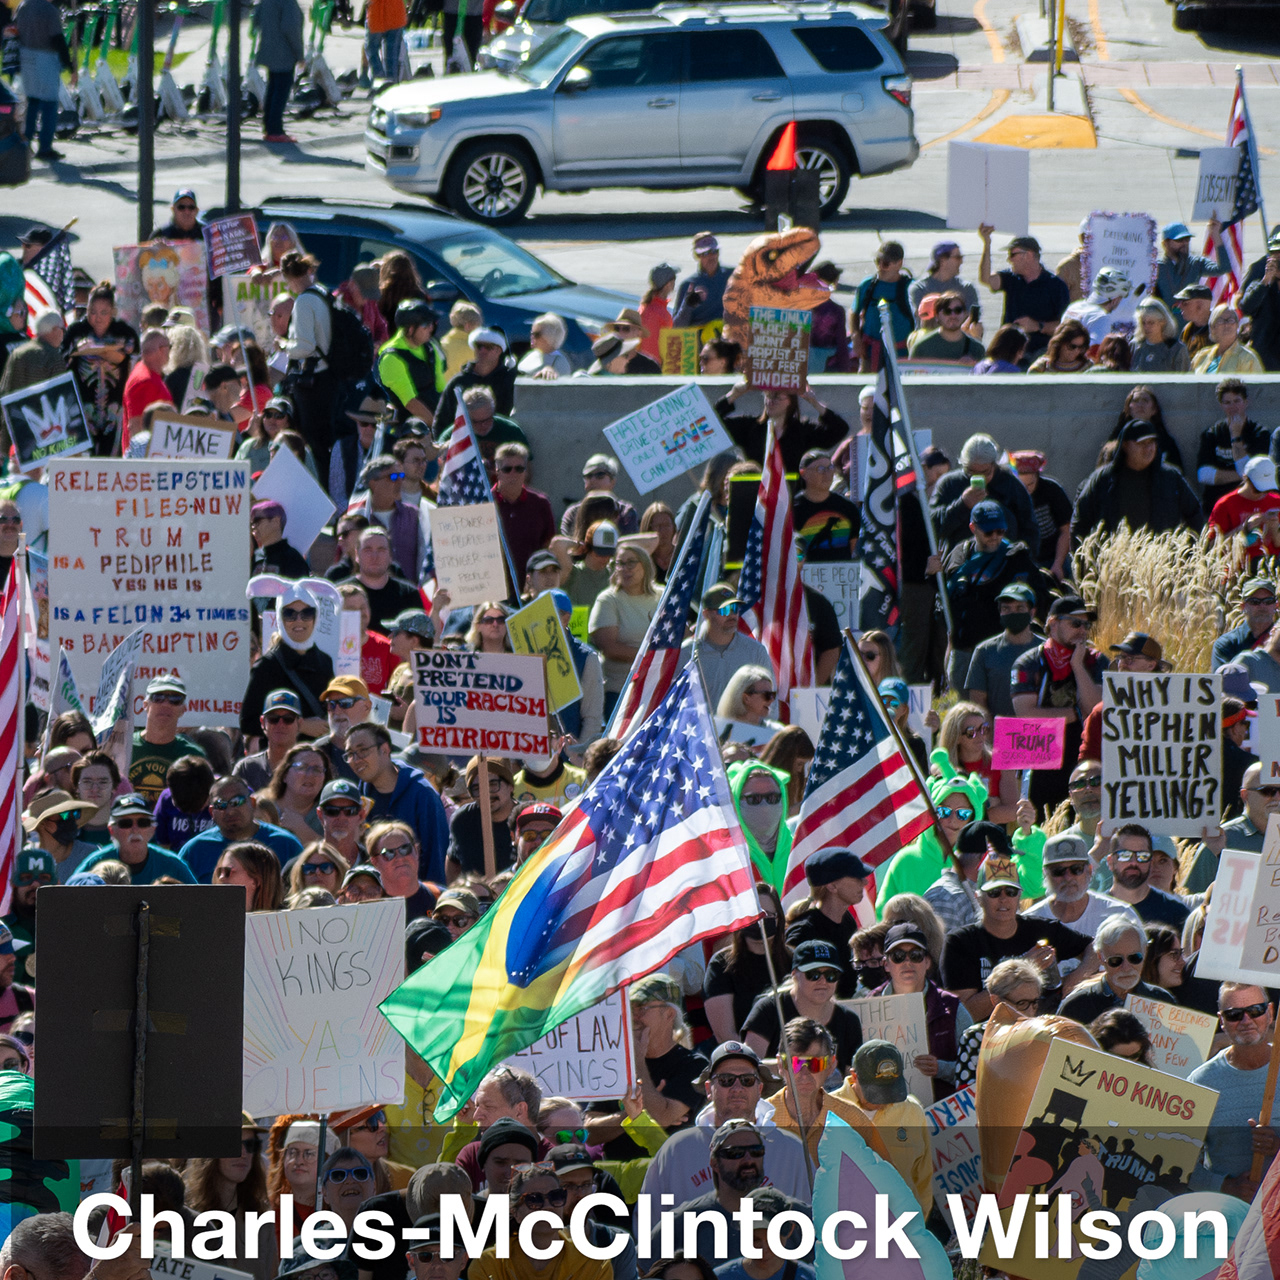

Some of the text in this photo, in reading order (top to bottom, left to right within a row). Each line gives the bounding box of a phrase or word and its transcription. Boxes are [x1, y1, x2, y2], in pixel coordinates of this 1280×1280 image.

[752, 322, 789, 336] PLACE
[753, 309, 810, 324] THE ONLY
[748, 348, 806, 361] RAPIST IS
[754, 337, 800, 349] WANT A
[753, 359, 799, 373] SIX FEET
[752, 373, 799, 388] UNDER
[609, 386, 700, 442] HATE CANNOT
[165, 425, 222, 455] MAKE
[620, 407, 697, 456] DRIVE OUT HATE
[632, 416, 714, 465] ONLY LOVE
[641, 437, 714, 483] CAN DO THAT
[90, 526, 210, 549] TRUMP
[53, 553, 213, 574] IS A PEDIPHILE
[112, 578, 202, 592] YES HE IS
[417, 670, 523, 692] PRETEND
[1107, 676, 1215, 708] WHY IS
[420, 690, 546, 717] YOUR RACISM
[436, 706, 457, 724] IS
[1103, 707, 1217, 744] STEPHEN
[418, 726, 549, 755] PATRIOTISM
[1006, 732, 1055, 750] TRUMP
[1117, 744, 1212, 778] MILLER
[1104, 778, 1219, 819] YELLING?
[298, 917, 349, 945] NO
[275, 950, 372, 997] KINGS
[1097, 1070, 1196, 1121] NO KINGS
[1098, 1141, 1156, 1184] TRUMP
